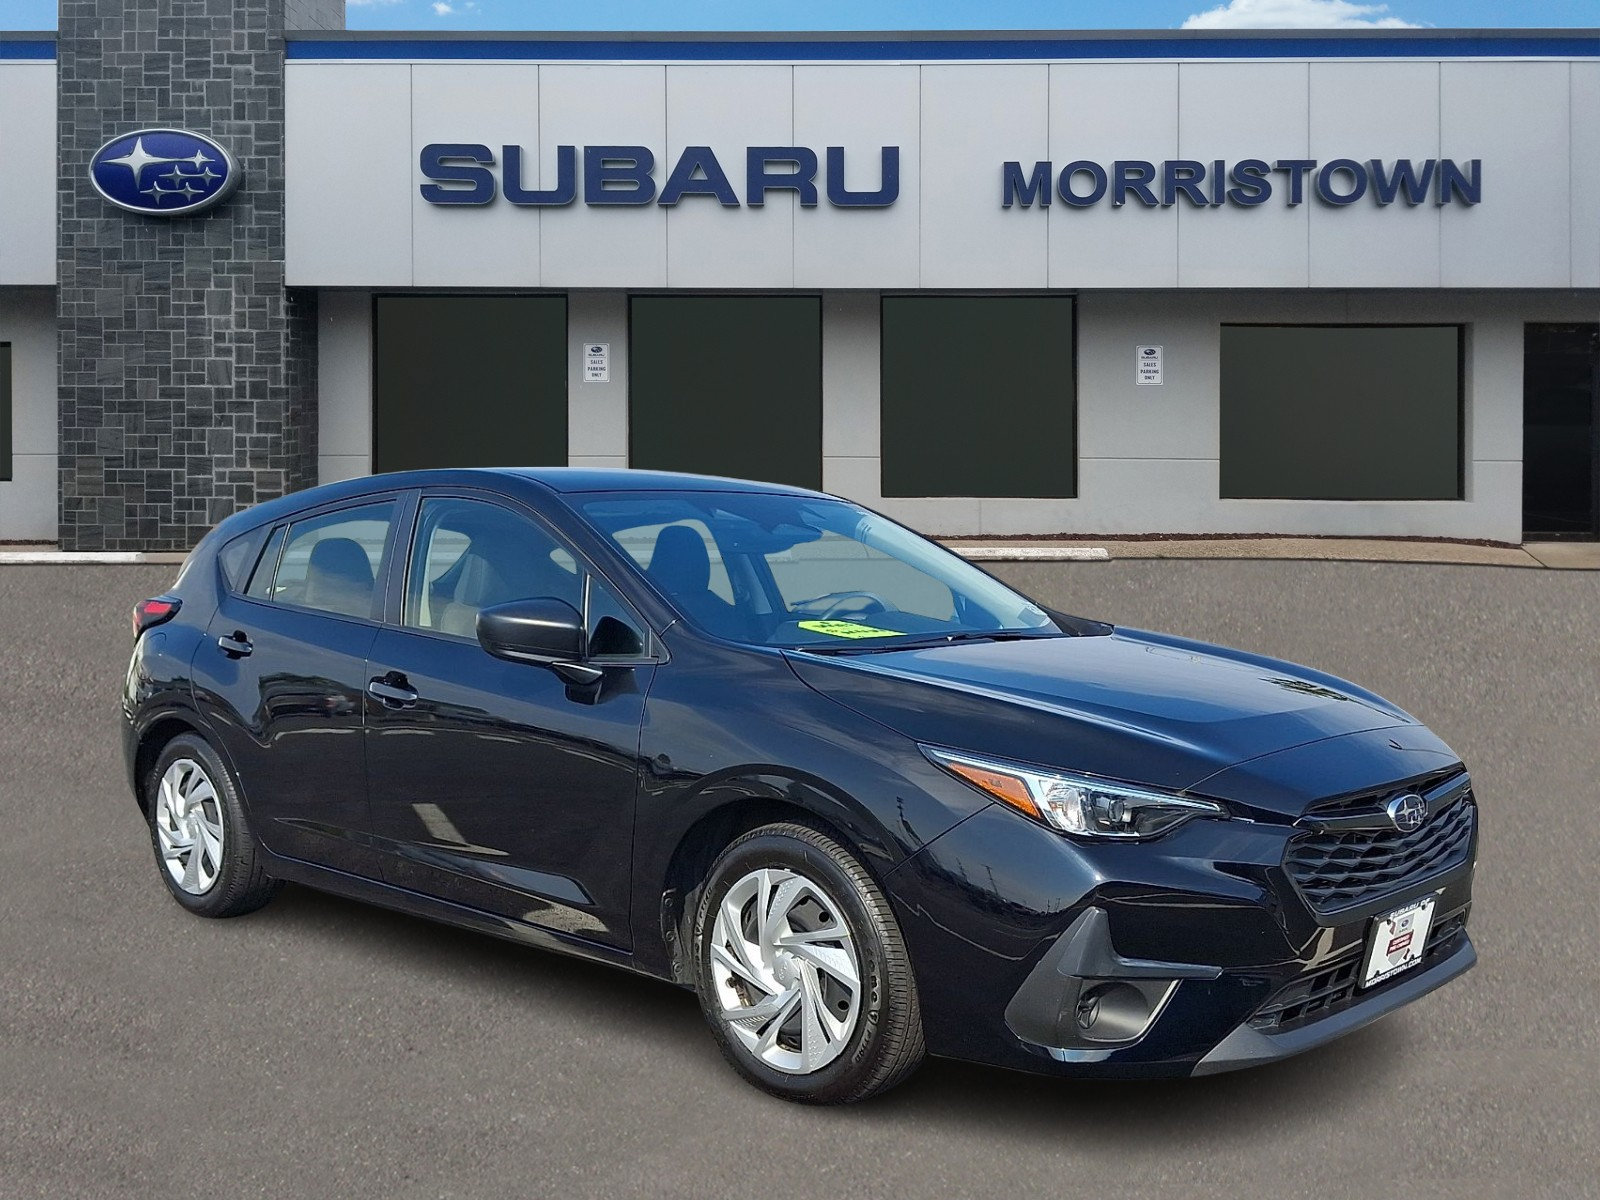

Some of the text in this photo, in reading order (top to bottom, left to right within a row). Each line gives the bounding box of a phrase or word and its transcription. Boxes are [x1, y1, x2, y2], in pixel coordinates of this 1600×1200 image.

[420, 143, 900, 207] SUBARU
[1001, 158, 1482, 208] MORRISTOWN
[1390, 902, 1420, 918] SUBARU
